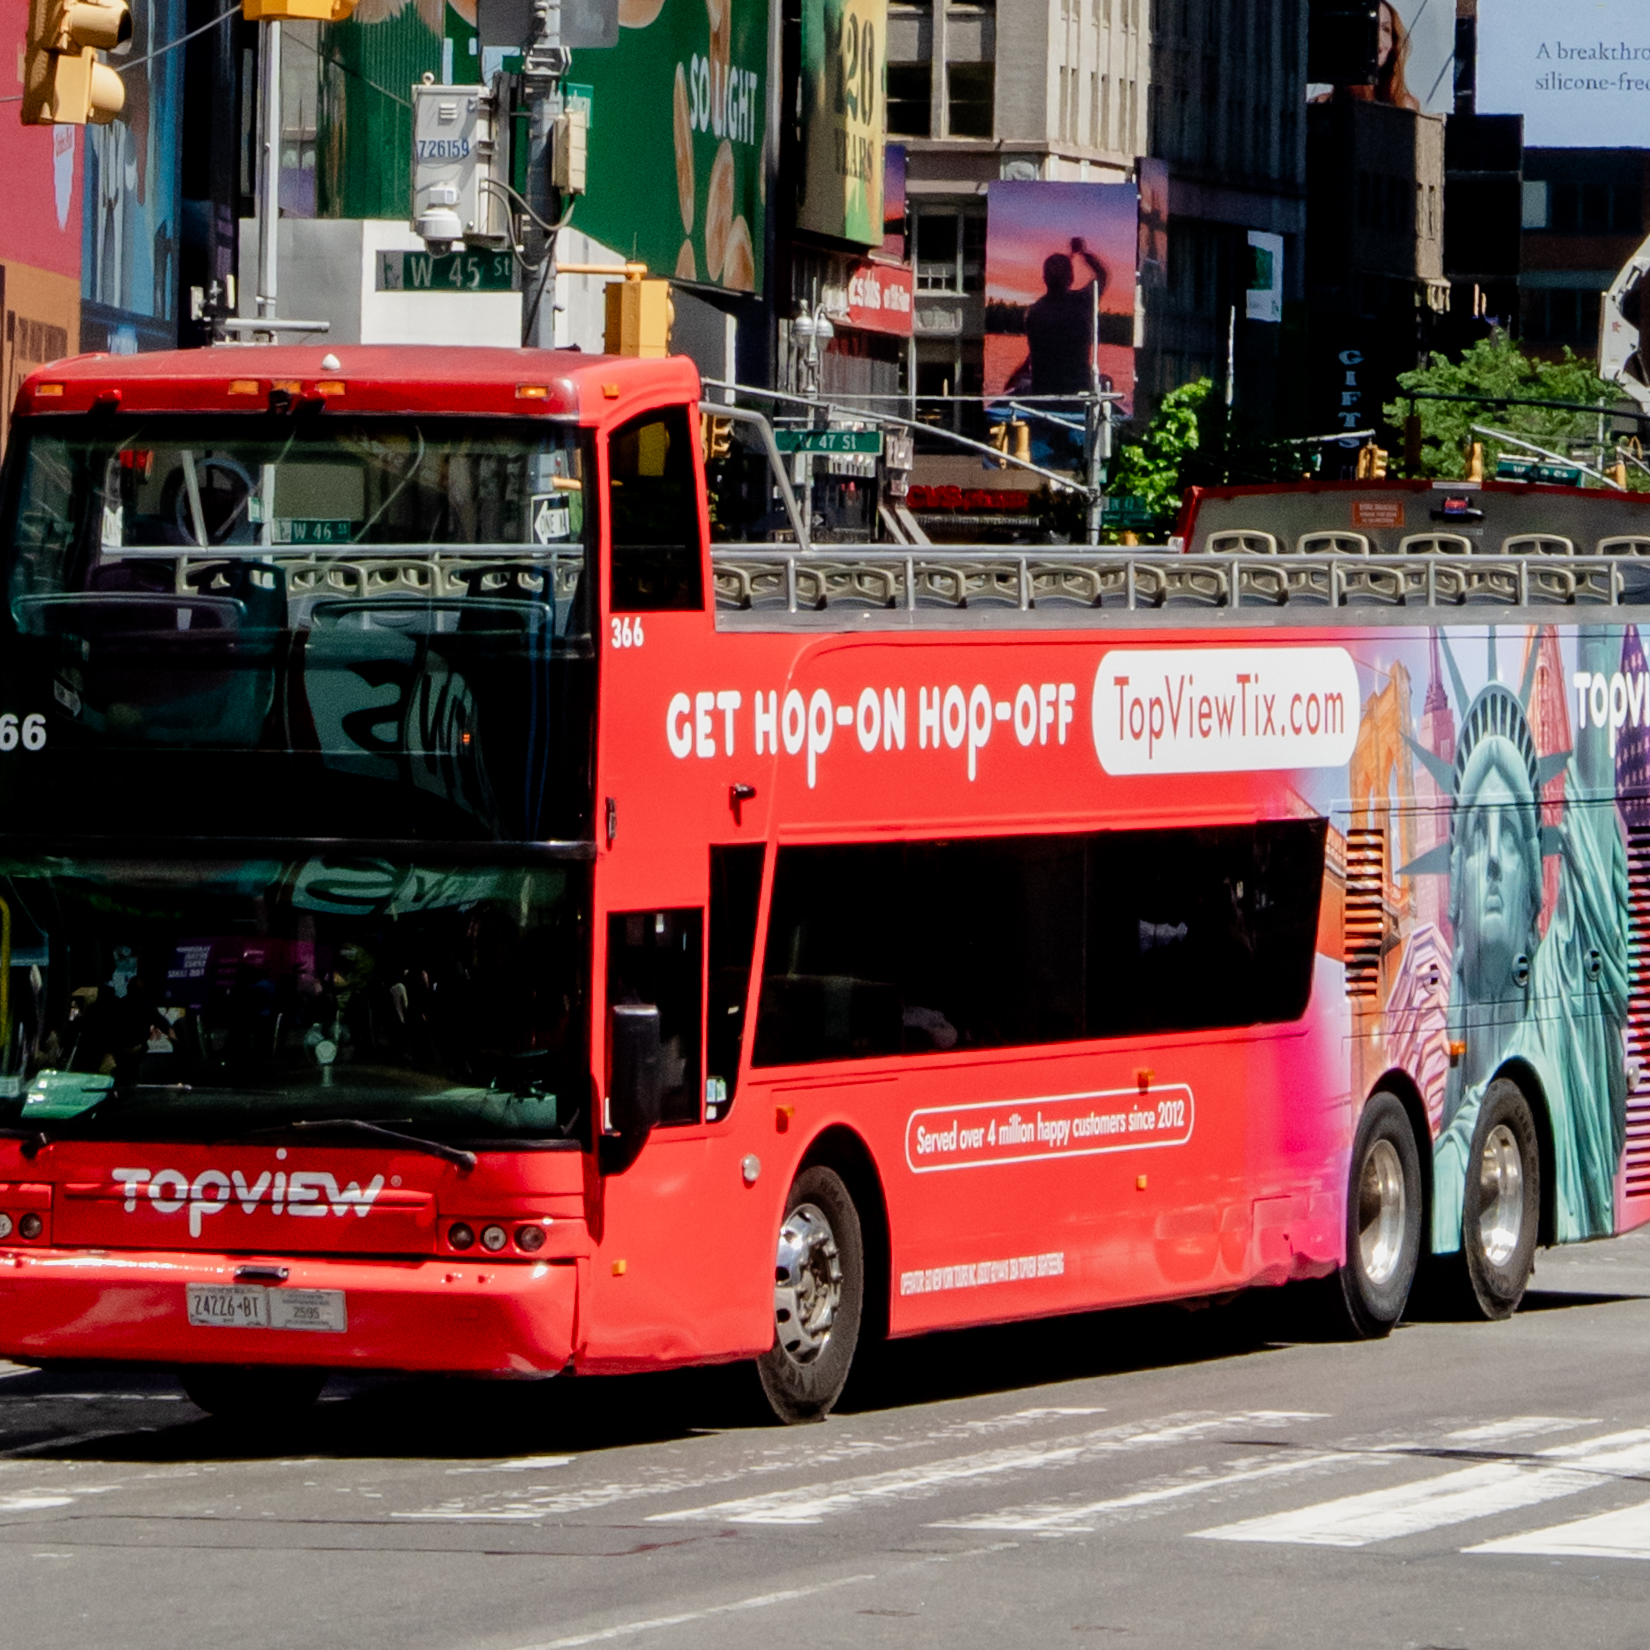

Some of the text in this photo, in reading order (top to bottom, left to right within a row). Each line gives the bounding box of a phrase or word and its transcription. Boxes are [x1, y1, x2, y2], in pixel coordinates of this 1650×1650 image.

[1536, 43, 1552, 61] A
[691, 53, 758, 147] SO LIGHT
[417, 138, 470, 160] 726159
[410, 255, 512, 289] W 45 St
[818, 433, 836, 450] 47
[611, 616, 644, 648] 366
[666, 691, 742, 759] GET
[1113, 672, 1346, 741] TopViewTix.com
[917, 1100, 1185, 1155] Served over 4 million happy customers since 2012
